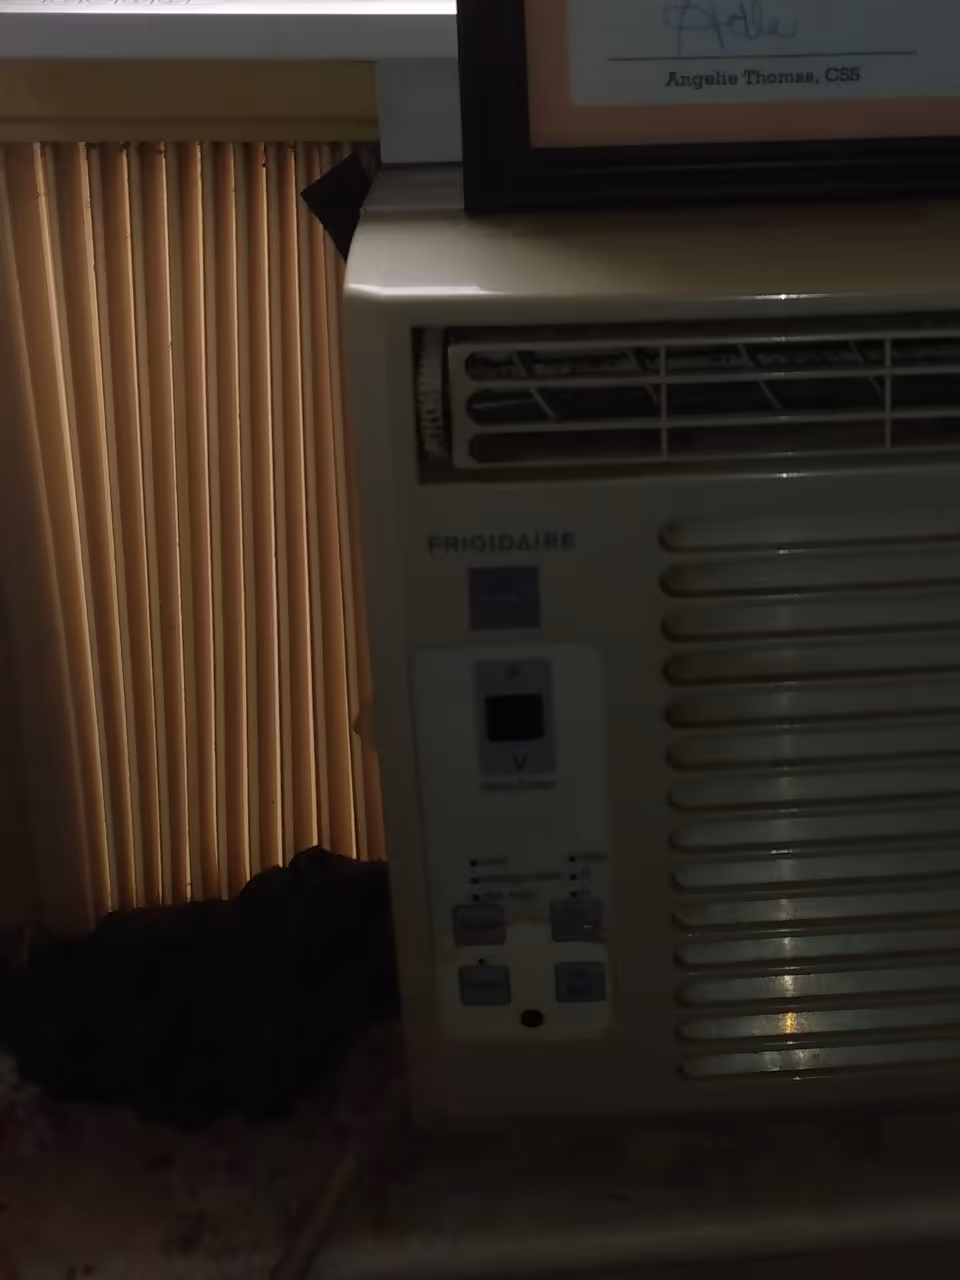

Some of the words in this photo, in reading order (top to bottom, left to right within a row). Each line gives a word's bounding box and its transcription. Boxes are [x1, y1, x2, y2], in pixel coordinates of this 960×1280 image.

[665, 71, 738, 89] Angelie
[743, 69, 820, 85] Thomas,
[426, 530, 577, 555] FRIGIDAIRE
